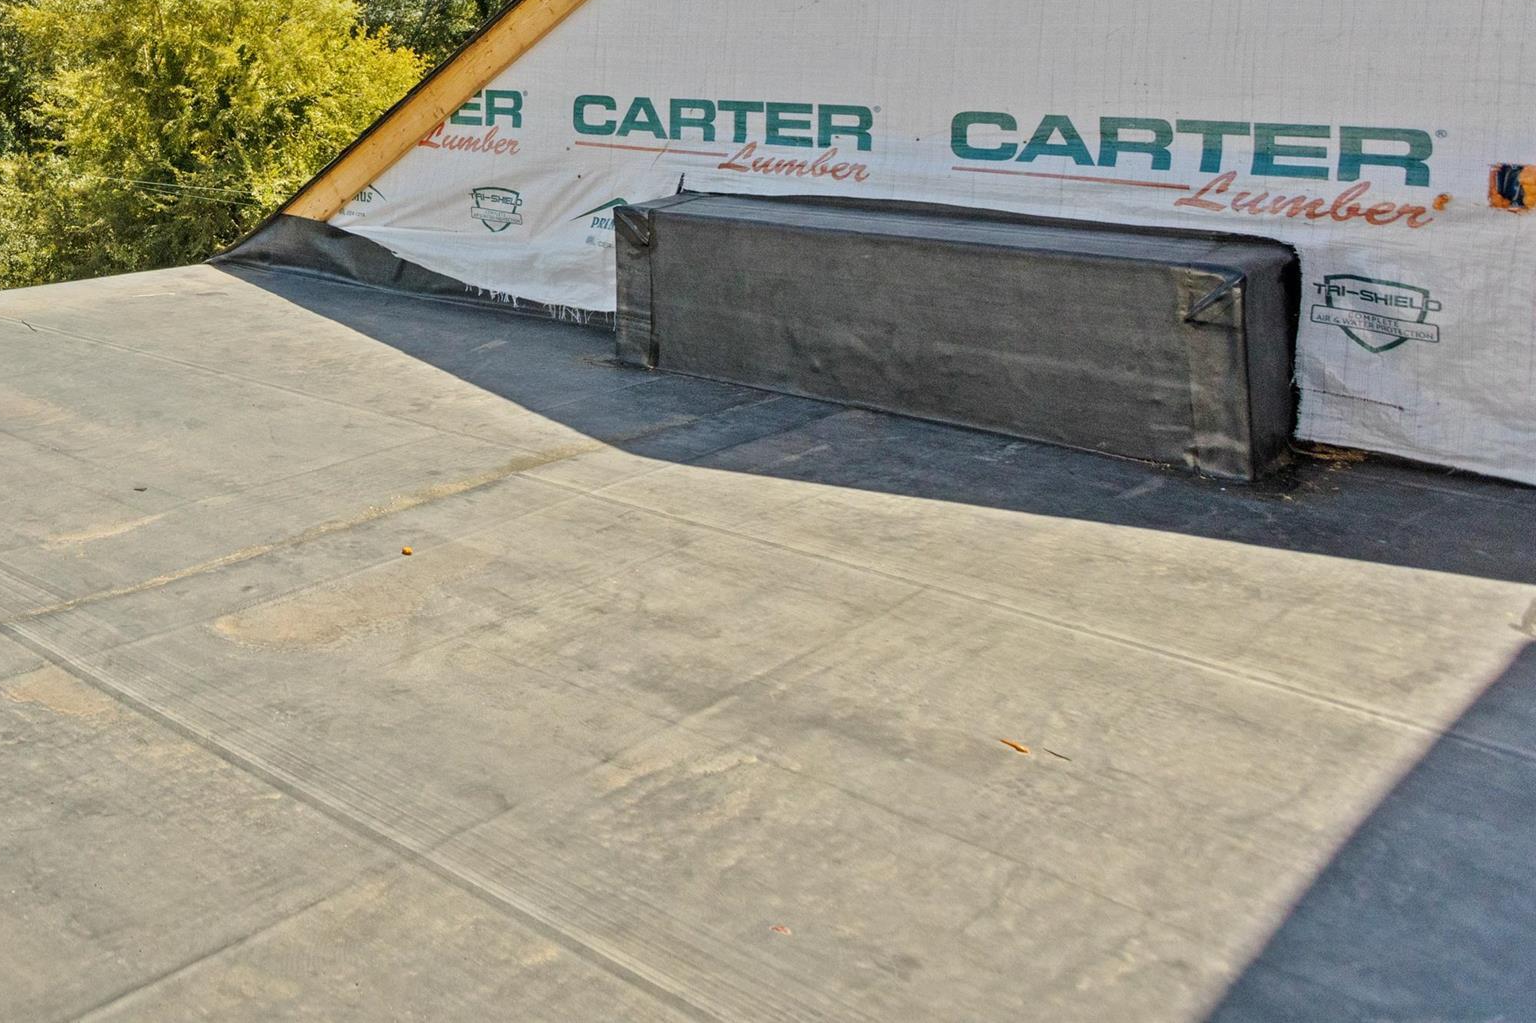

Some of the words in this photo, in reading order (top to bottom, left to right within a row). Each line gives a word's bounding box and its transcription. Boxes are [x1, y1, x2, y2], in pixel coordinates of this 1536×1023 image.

[417, 122, 521, 155] Lumber
[572, 94, 874, 151] CARTER
[717, 142, 870, 182] Lumber
[950, 111, 1433, 187] CARTER
[469, 192, 522, 206] TRI-SHIELD
[1173, 171, 1435, 228] Lumber
[1312, 282, 1442, 312] TRI-SHIELD
